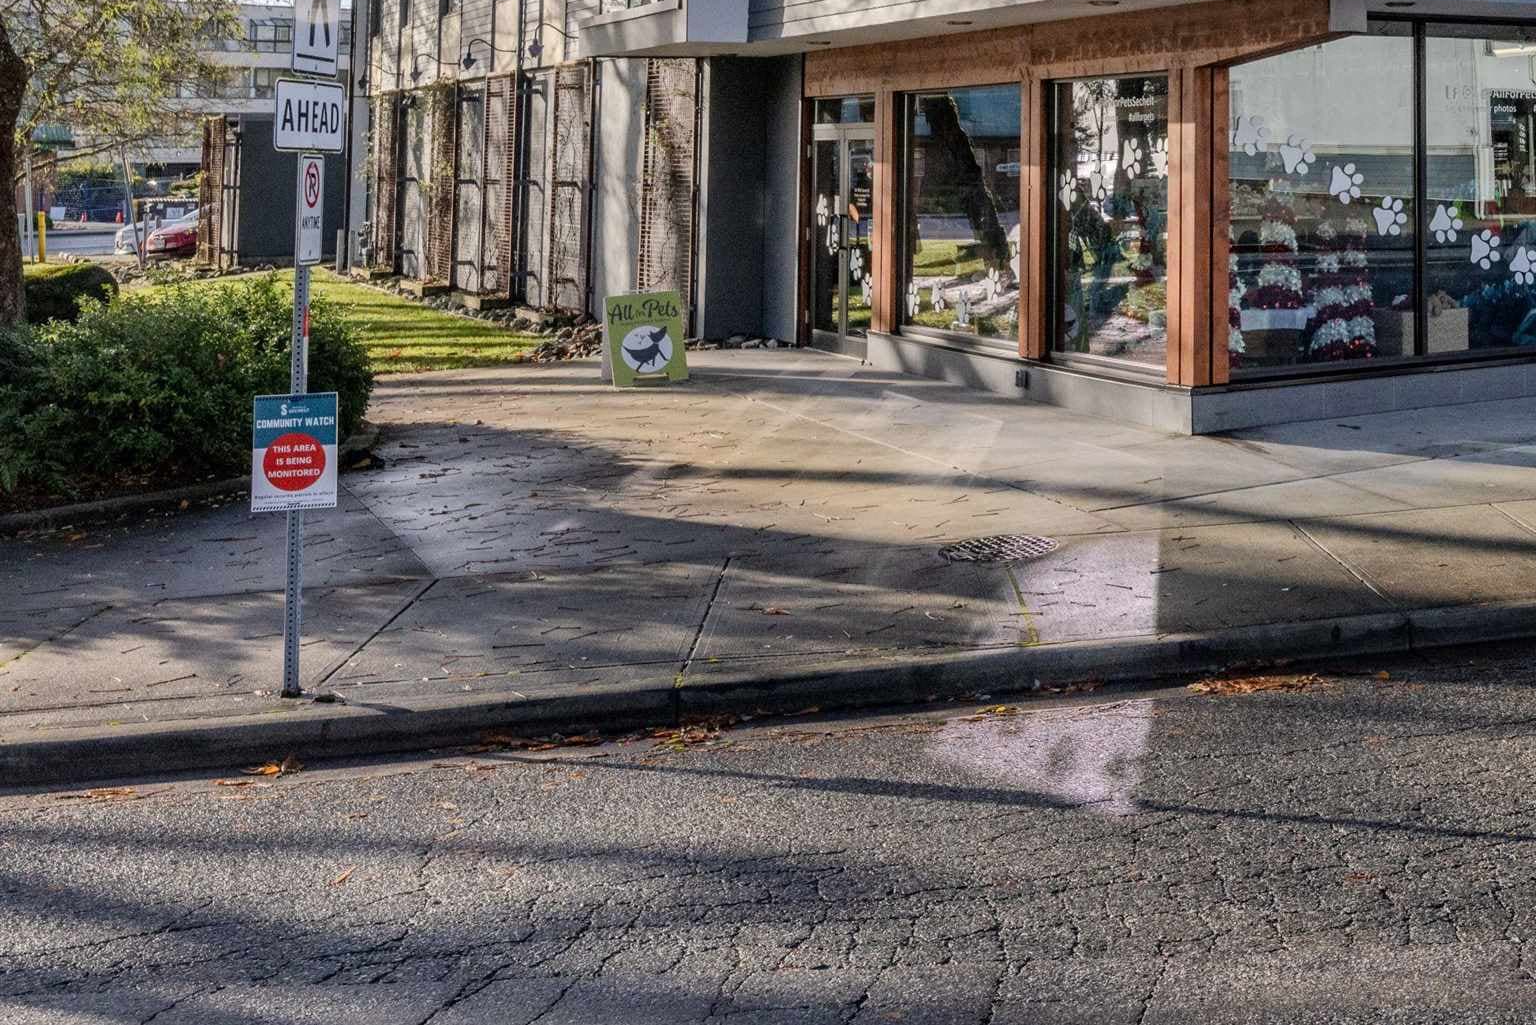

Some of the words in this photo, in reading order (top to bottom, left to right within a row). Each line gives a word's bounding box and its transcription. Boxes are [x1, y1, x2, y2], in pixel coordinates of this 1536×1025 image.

[1493, 103, 1517, 114] photos
[281, 98, 339, 134] AHEAD
[608, 303, 634, 325] All
[642, 298, 679, 318] Pets
[256, 417, 303, 429] COMMUNITY
[304, 415, 335, 427] WATCH
[273, 444, 292, 454] THIS
[293, 443, 317, 453] AREA
[276, 457, 285, 466] IS
[286, 455, 313, 466] BEING
[267, 467, 321, 479] MONITORED
